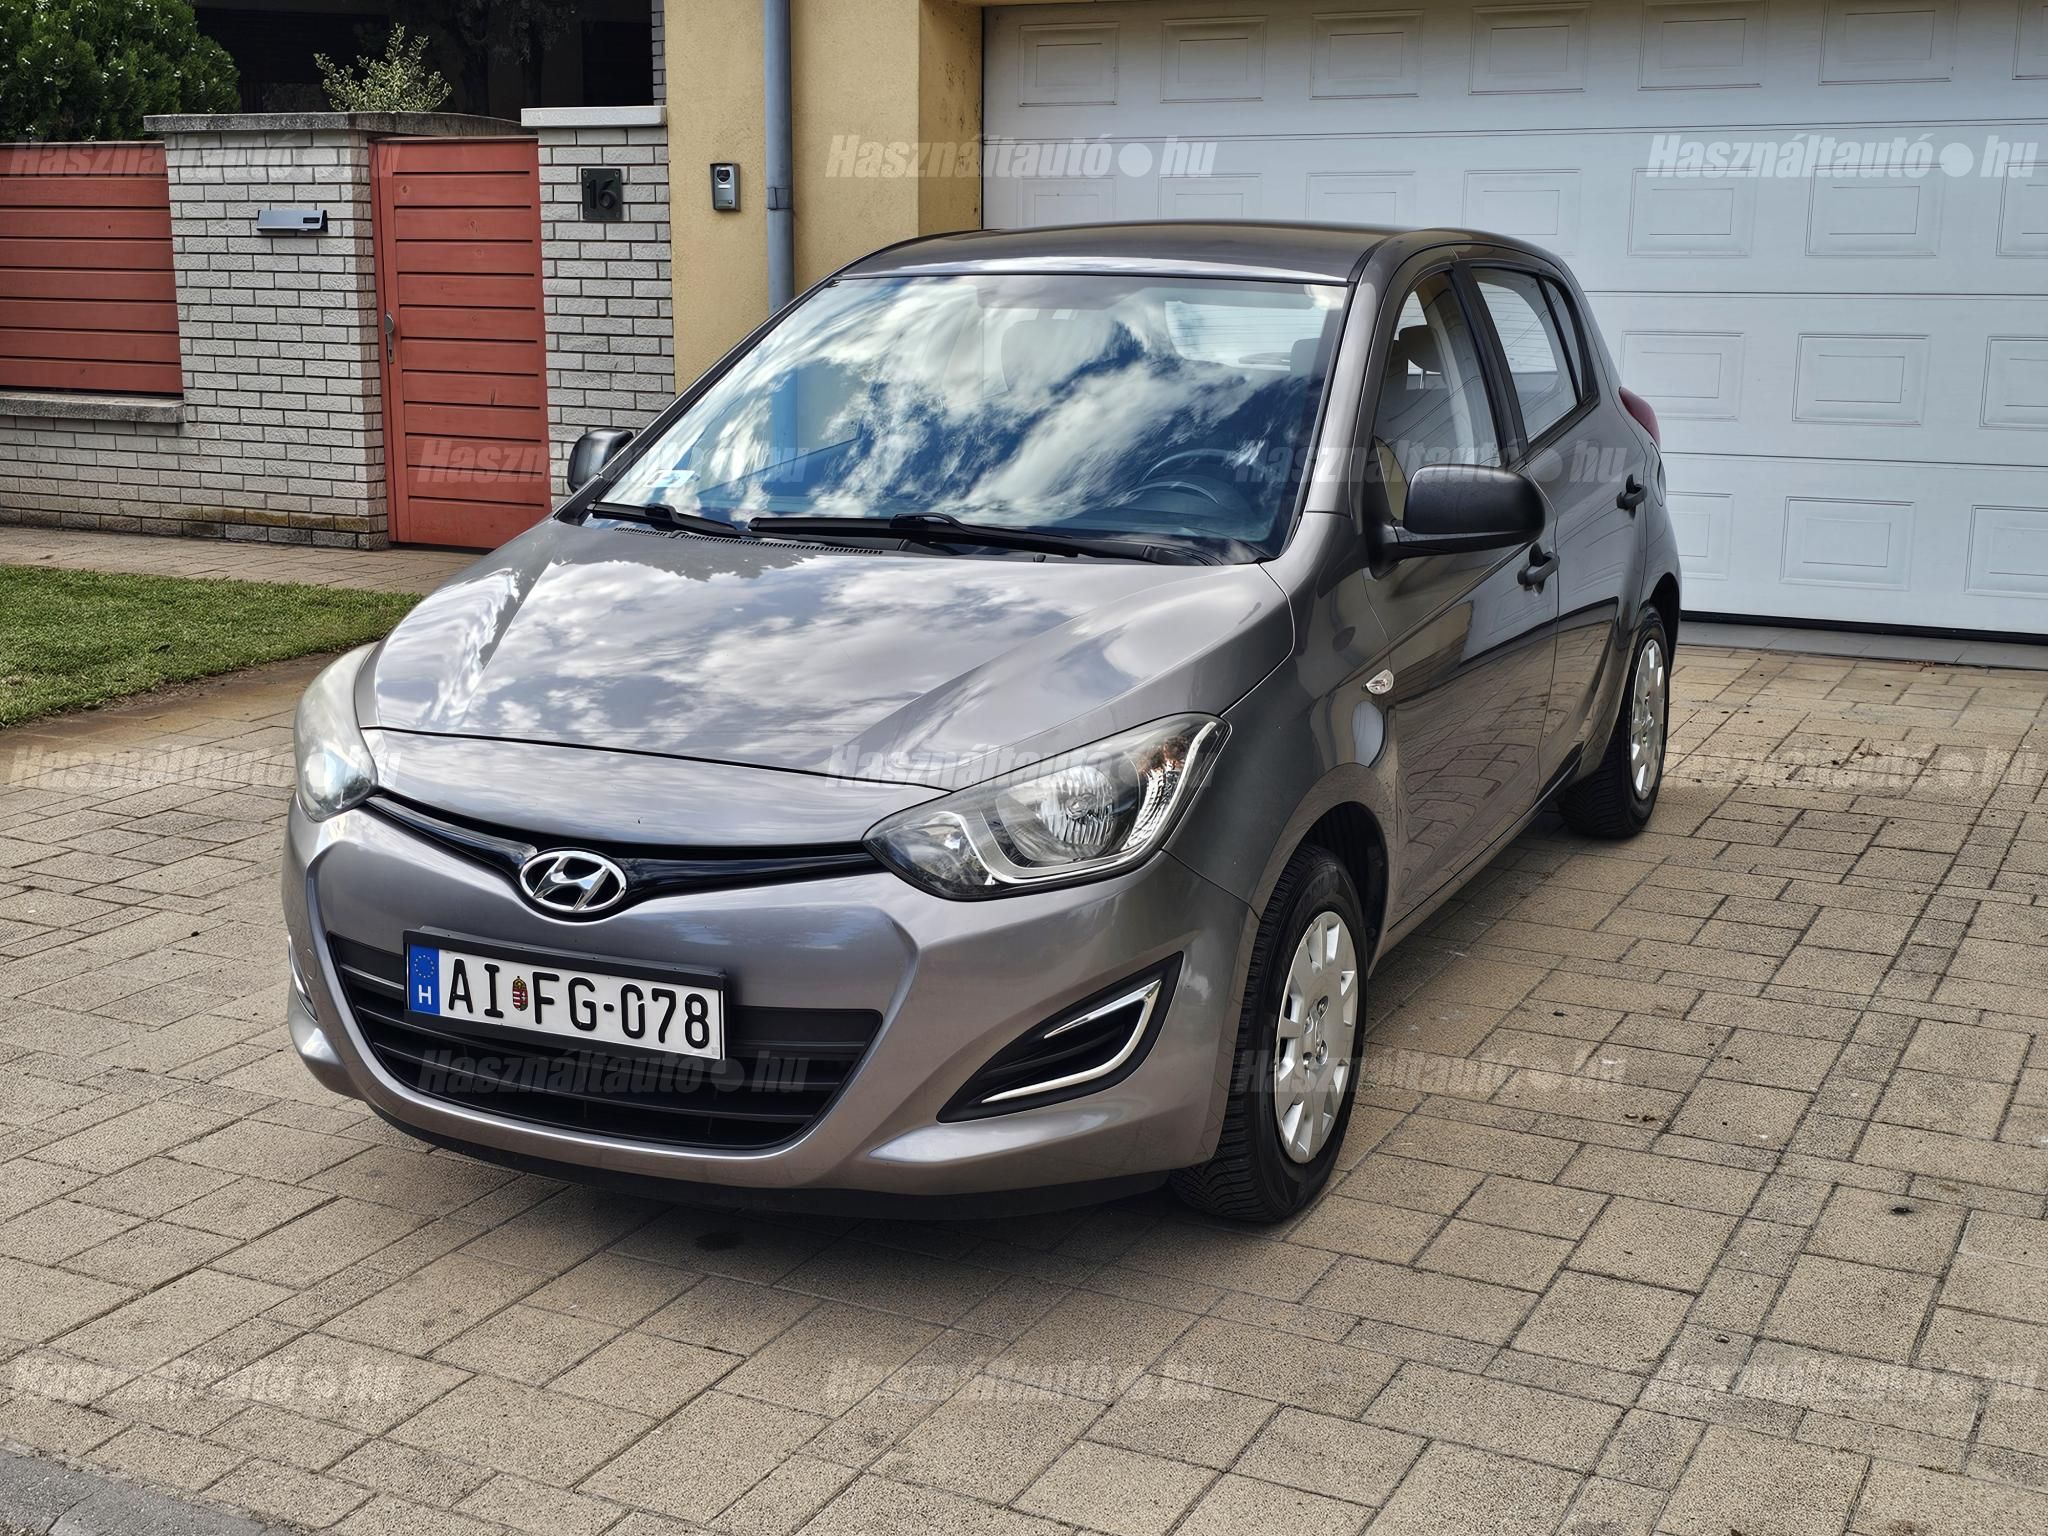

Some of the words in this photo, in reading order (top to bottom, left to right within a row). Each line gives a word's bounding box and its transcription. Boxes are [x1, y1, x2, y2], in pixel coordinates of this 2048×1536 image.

[586, 179, 617, 210] 16
[418, 985, 432, 1005] H
[448, 958, 504, 1019] AI
[532, 971, 711, 1050] FG-078
